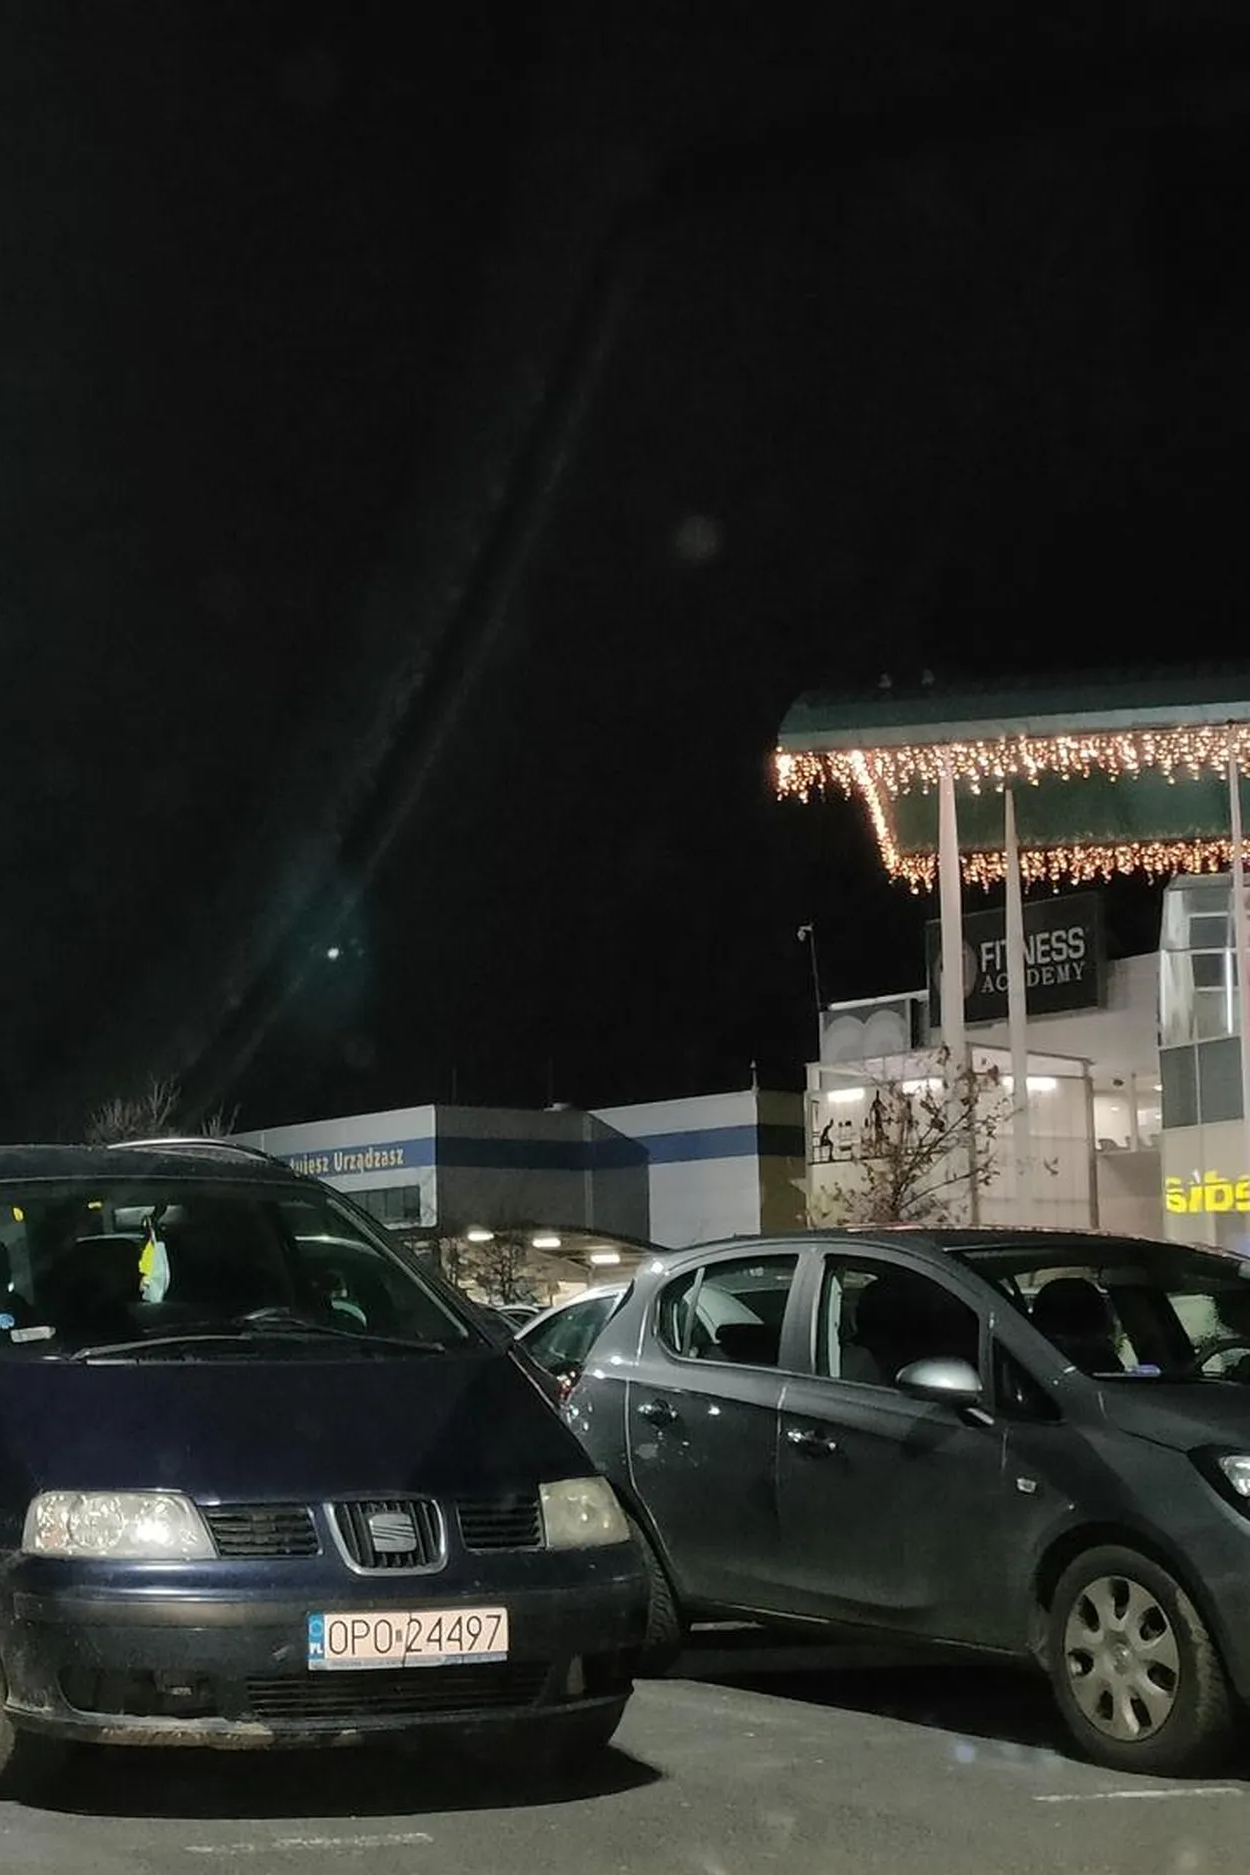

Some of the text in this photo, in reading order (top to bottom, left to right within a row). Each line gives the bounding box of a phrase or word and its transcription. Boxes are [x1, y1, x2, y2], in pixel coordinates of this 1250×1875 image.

[980, 961, 1085, 994] ACDEMY
[290, 1152, 329, 1177] ujesz
[329, 1614, 501, 1655] OPO 24497
